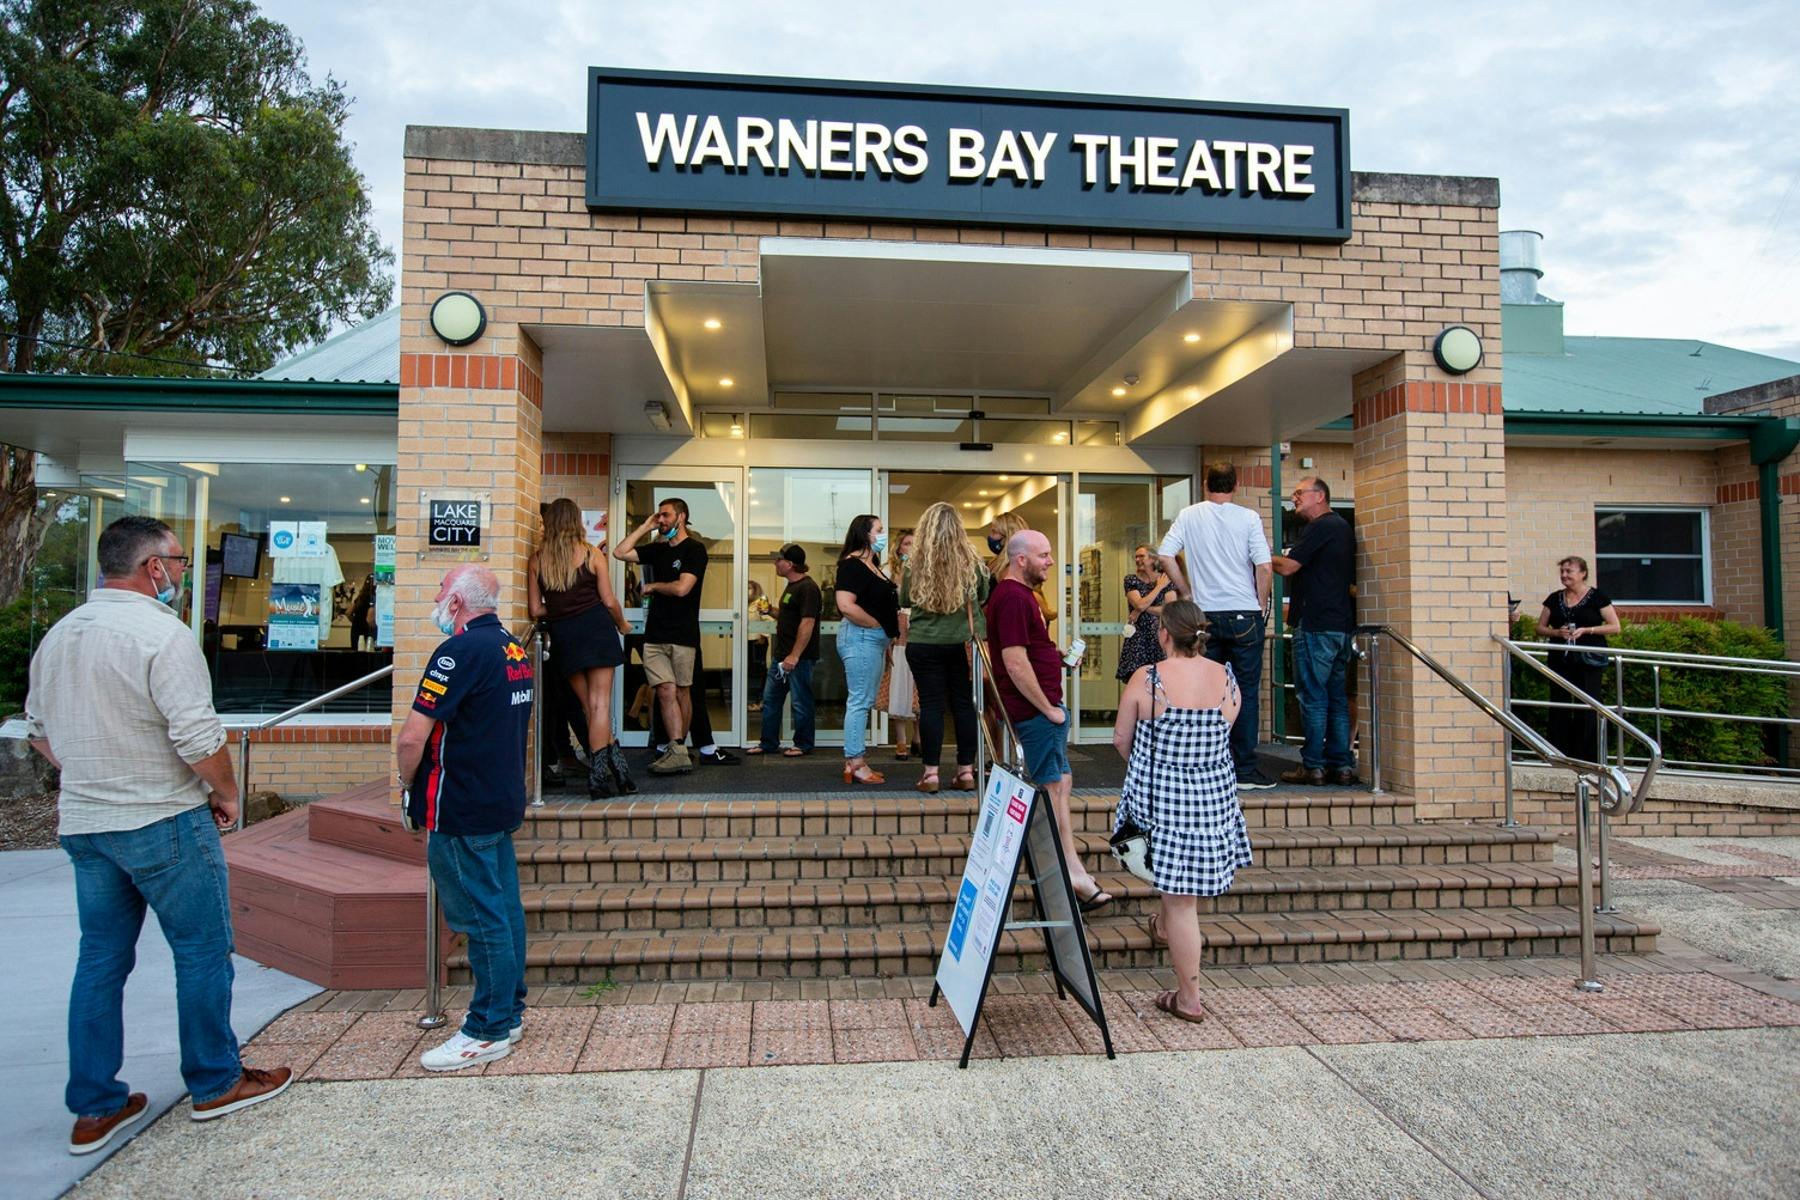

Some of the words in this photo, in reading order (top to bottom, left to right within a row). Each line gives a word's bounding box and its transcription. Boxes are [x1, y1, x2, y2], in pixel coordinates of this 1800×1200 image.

[635, 111, 928, 176] WARNERS
[949, 127, 1058, 181] BAY
[1073, 133, 1316, 194] THEATRE
[433, 503, 477, 519] LAKE
[433, 526, 476, 542] CITY
